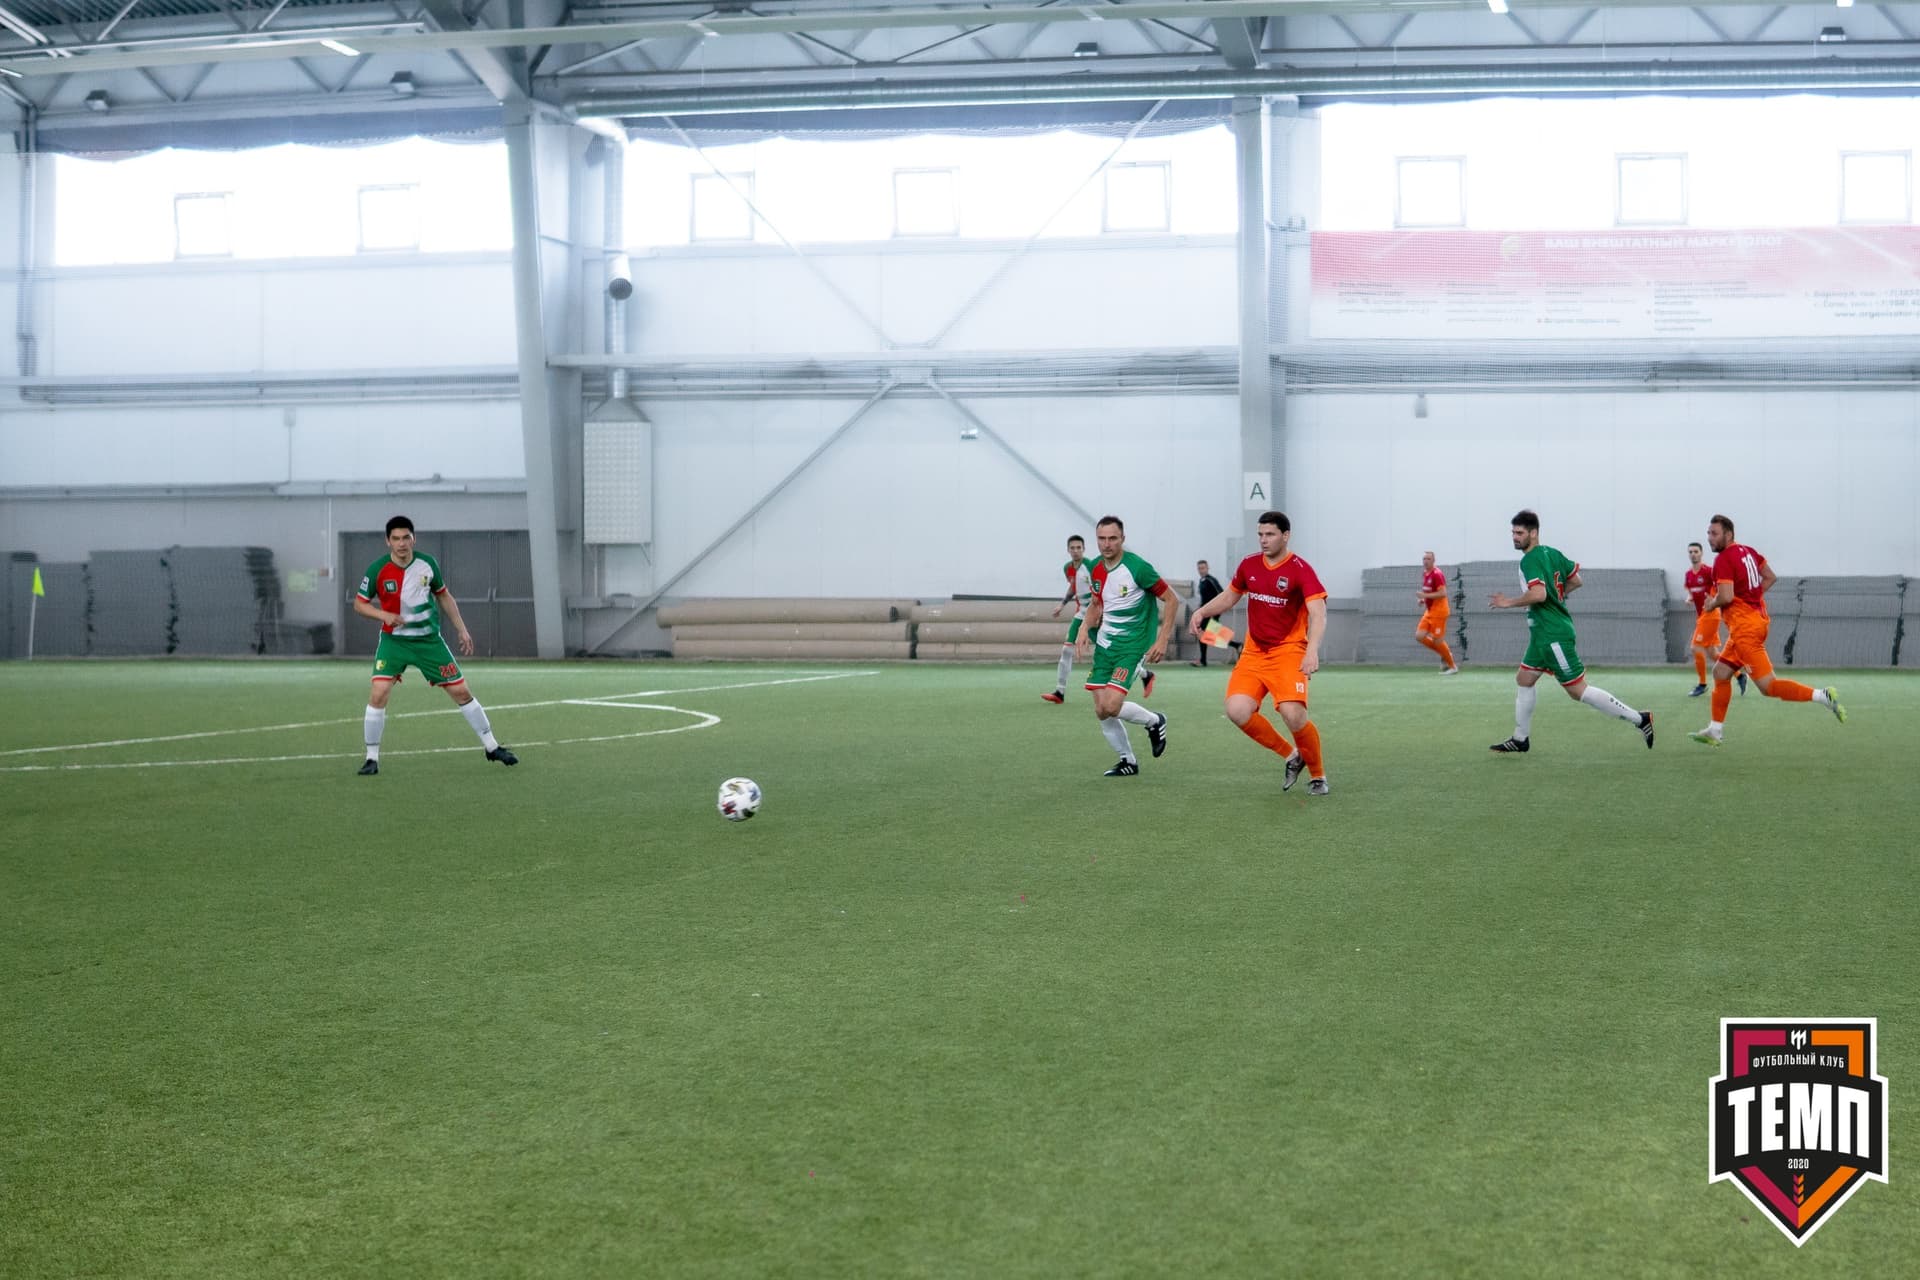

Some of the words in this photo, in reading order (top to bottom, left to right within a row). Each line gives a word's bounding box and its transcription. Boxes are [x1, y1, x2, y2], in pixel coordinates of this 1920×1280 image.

[1545, 238, 1579, 249] ВАШ
[1249, 482, 1266, 500] A
[1741, 553, 1760, 590] 10
